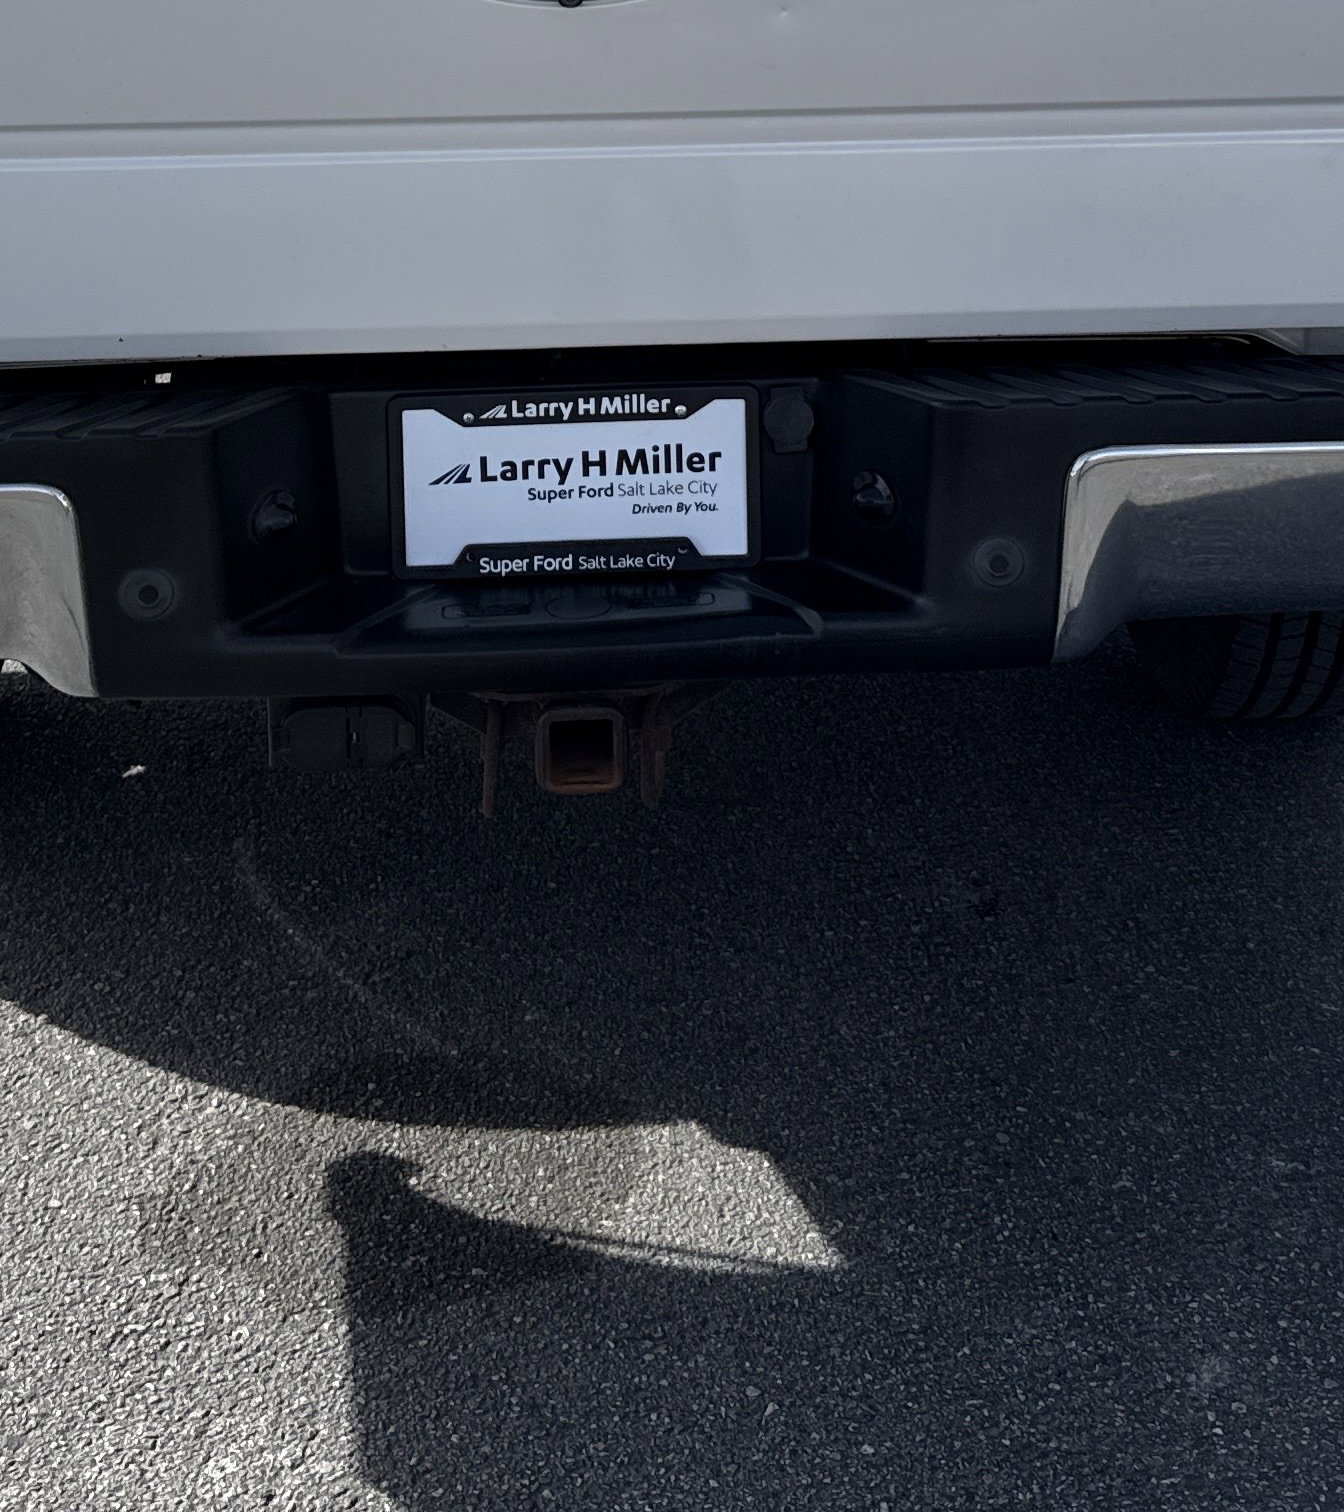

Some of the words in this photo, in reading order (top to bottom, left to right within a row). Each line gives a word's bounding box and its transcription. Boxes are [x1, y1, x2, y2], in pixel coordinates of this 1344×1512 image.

[511, 399, 575, 421] Larry
[578, 398, 595, 415] H
[600, 393, 671, 414] Miller
[479, 455, 574, 485] Larry
[581, 450, 607, 477] H
[615, 443, 722, 476] Miller
[527, 487, 574, 502] Super
[578, 483, 614, 498] Ford
[617, 482, 645, 498] Salt
[649, 481, 684, 497] Lake
[687, 480, 718, 497] City
[632, 502, 672, 515] Driven
[676, 501, 691, 516] By
[479, 558, 529, 576] Super
[533, 554, 573, 571] Ford
[578, 555, 607, 570] Salt
[610, 554, 644, 569] Lake
[647, 552, 676, 569] City
